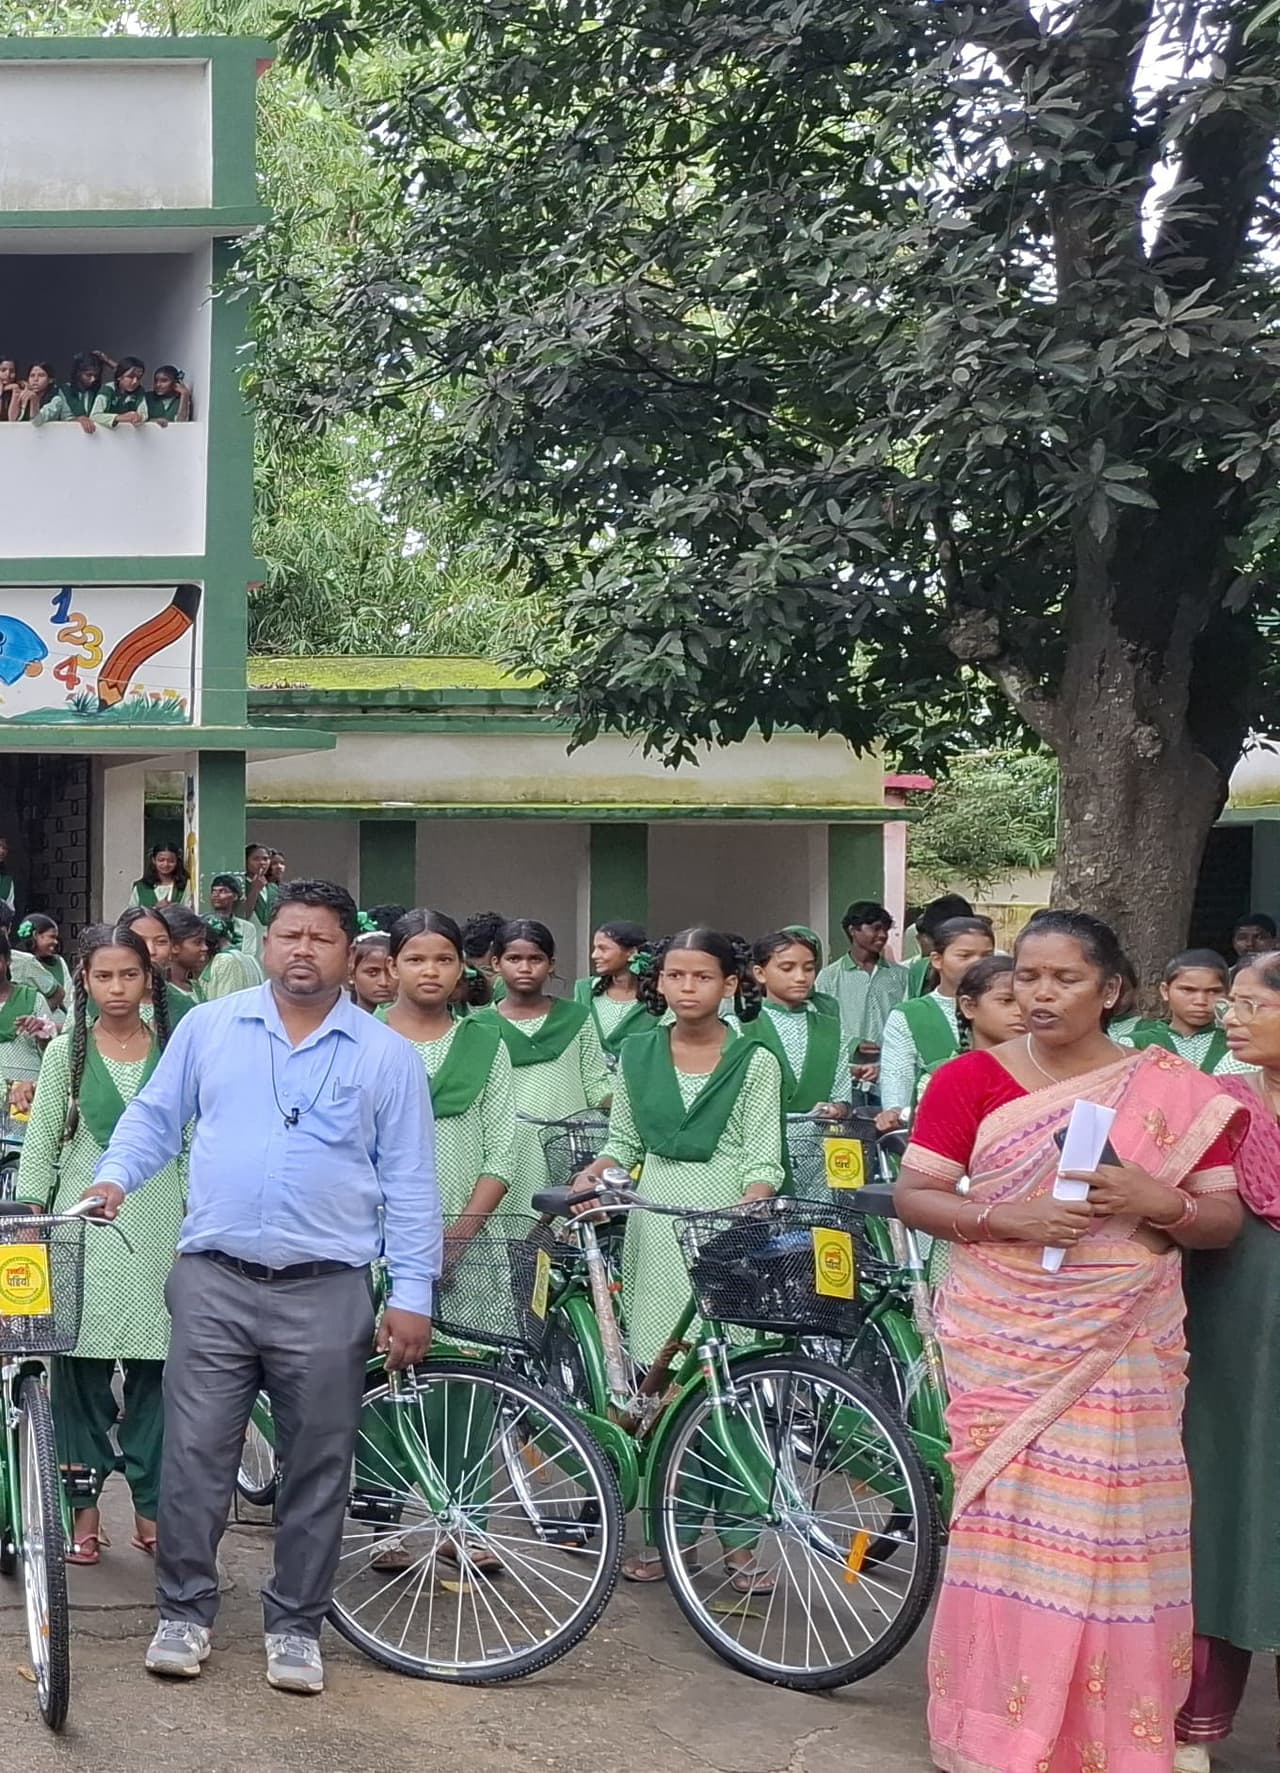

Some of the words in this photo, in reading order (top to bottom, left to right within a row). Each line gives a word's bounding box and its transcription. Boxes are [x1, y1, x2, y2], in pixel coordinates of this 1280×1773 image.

[51, 587, 72, 624] 1
[58, 612, 88, 645] 2
[76, 625, 104, 669] 3
[53, 656, 80, 690] 4
